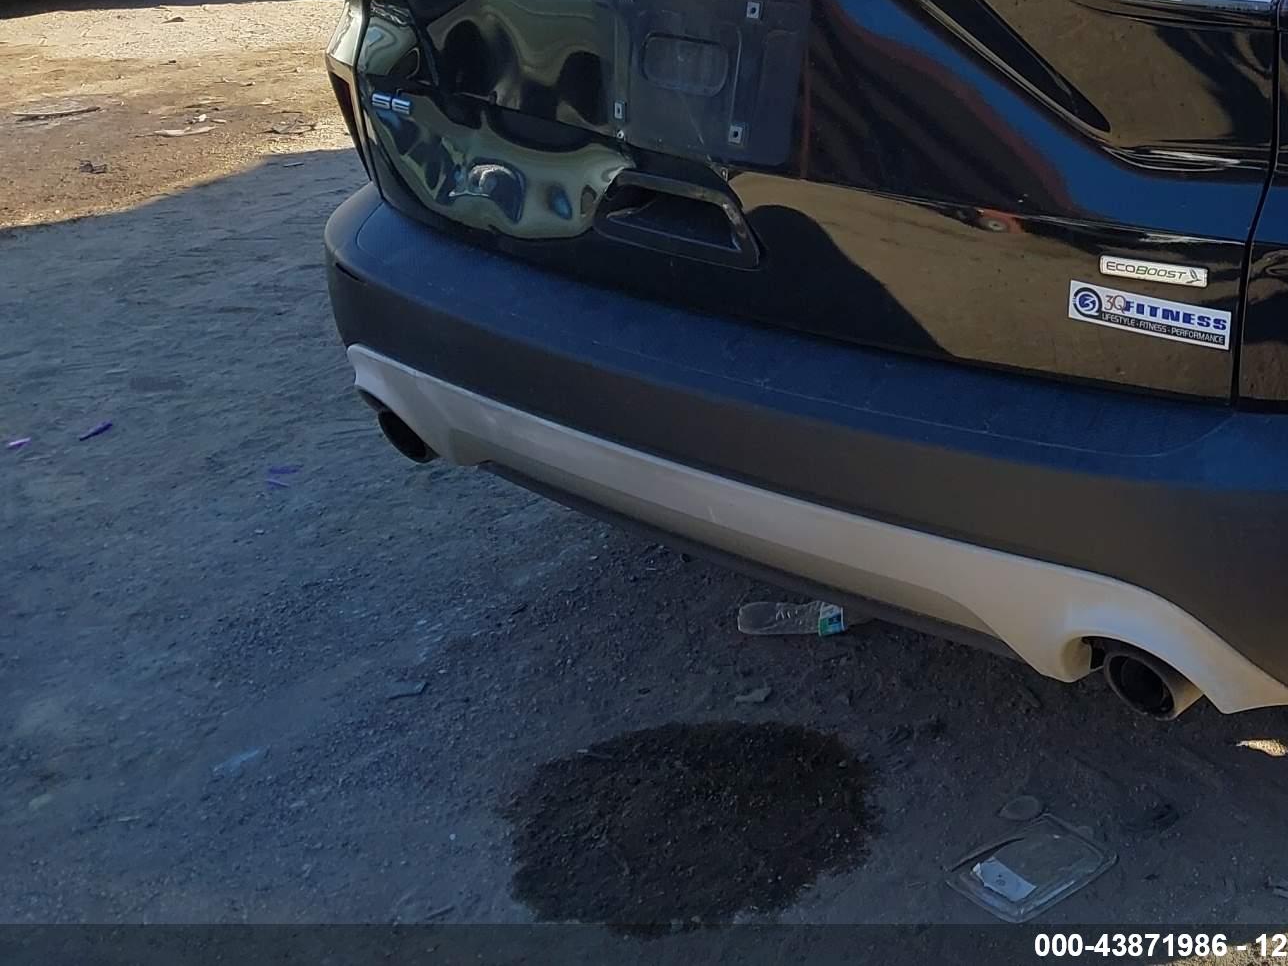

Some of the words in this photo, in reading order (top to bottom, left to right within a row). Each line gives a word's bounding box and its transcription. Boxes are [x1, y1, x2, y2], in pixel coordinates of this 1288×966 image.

[371, 93, 410, 114] SE
[1106, 261, 1187, 280] ECOBOOST
[1101, 312, 1137, 327] LIFESTYLE
[1139, 320, 1168, 334] FITNESS
[1171, 327, 1225, 345] PERFORMANCE
